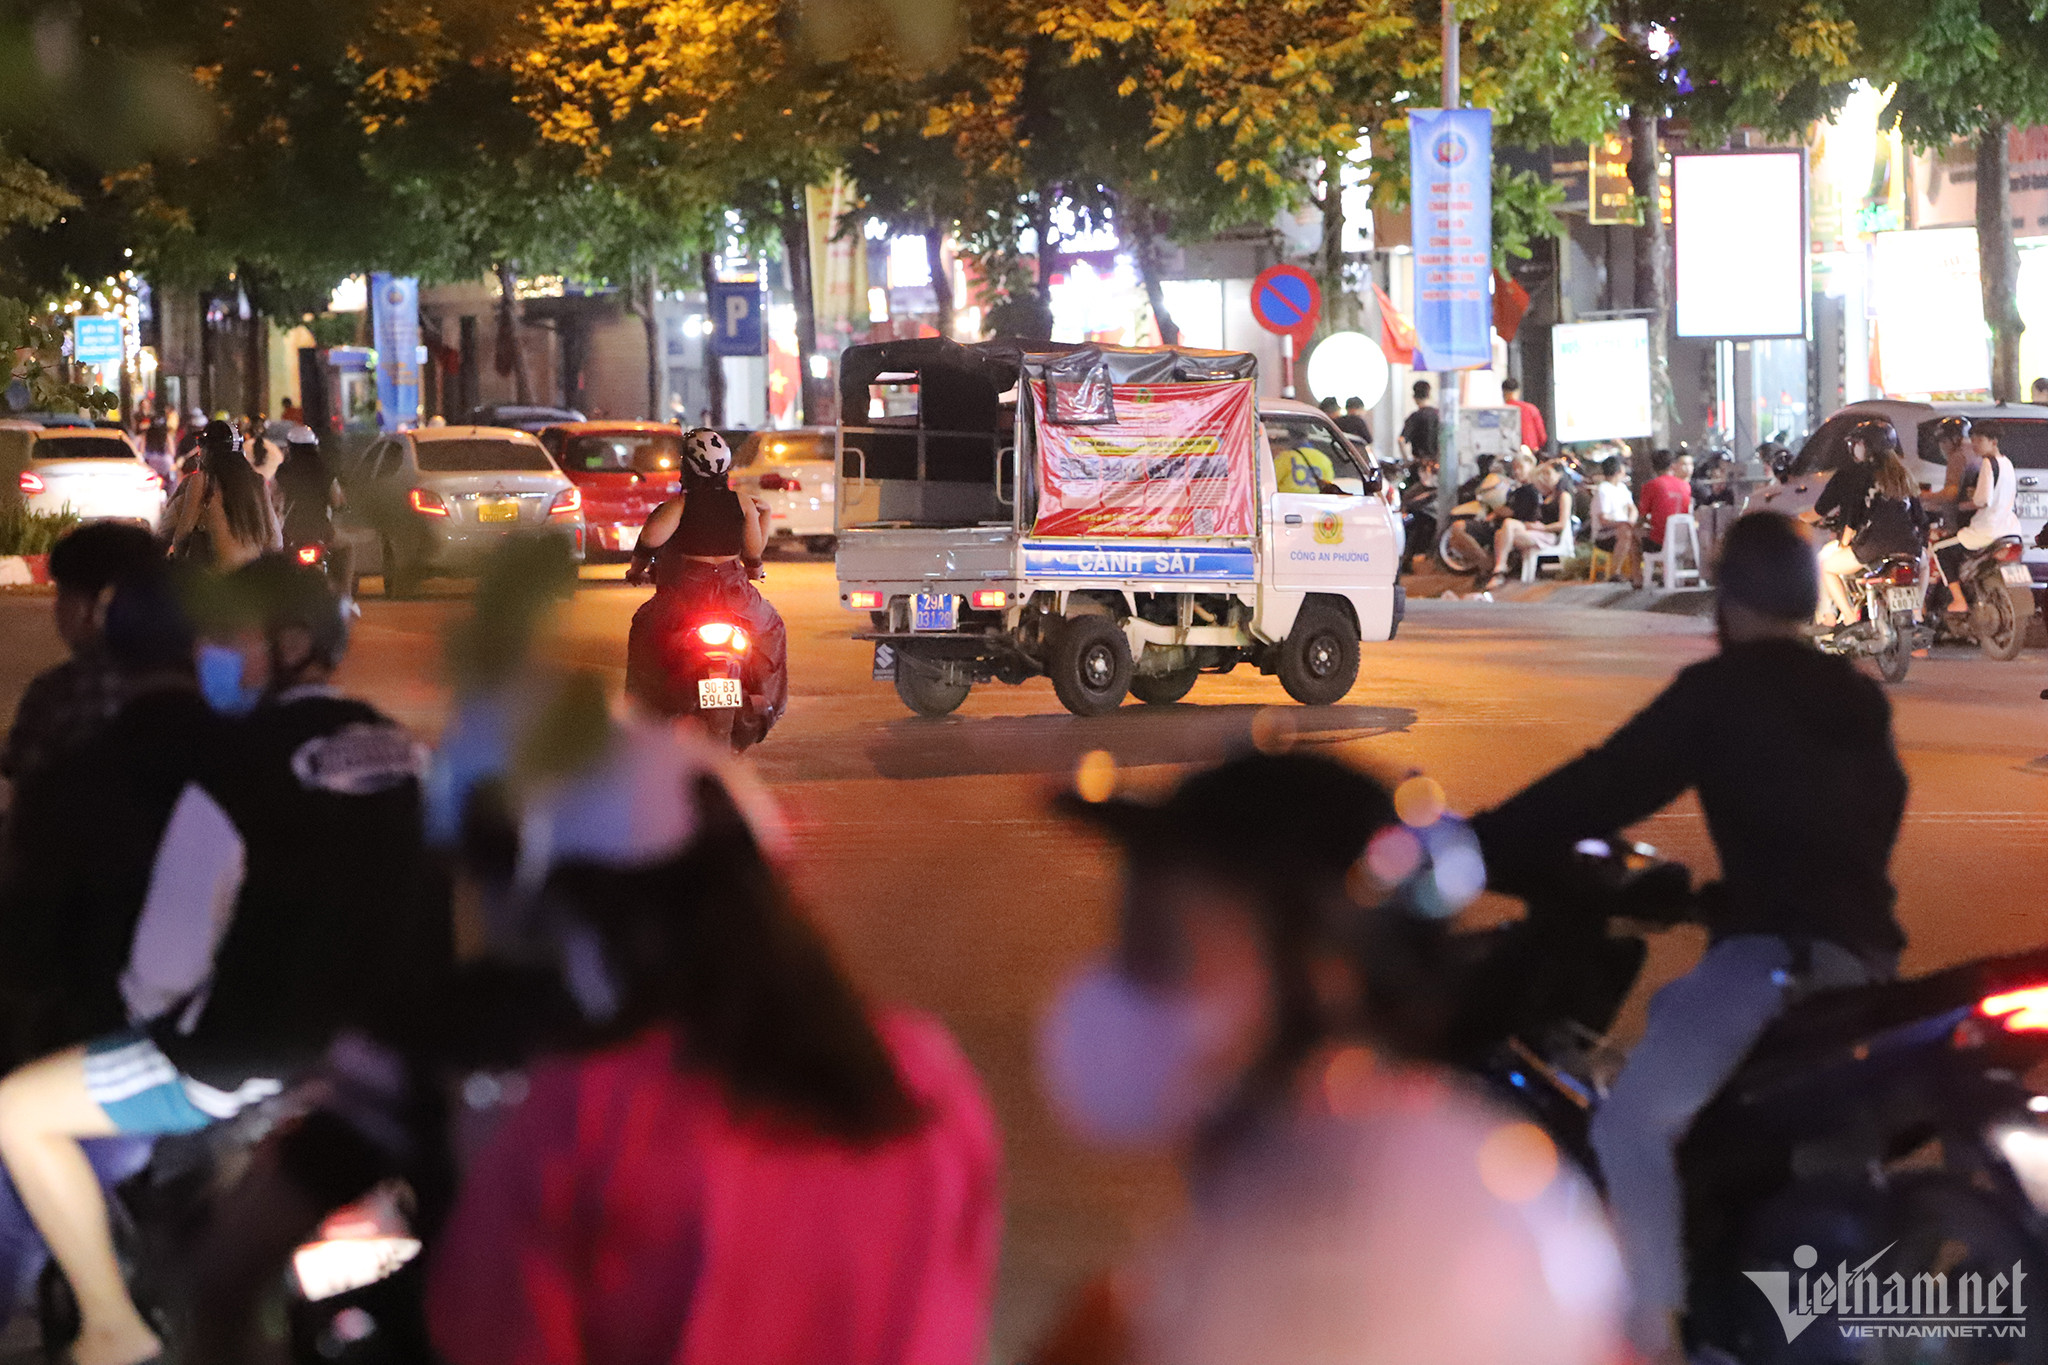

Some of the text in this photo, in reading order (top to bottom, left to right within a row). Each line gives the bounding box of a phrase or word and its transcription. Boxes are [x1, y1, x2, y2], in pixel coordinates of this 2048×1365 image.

[726, 295, 748, 337] P
[1077, 545, 1199, 573] CẢNH SÁT
[1290, 549, 1316, 561] CÔNG
[1318, 551, 1330, 561] AN
[923, 593, 944, 610] 29A
